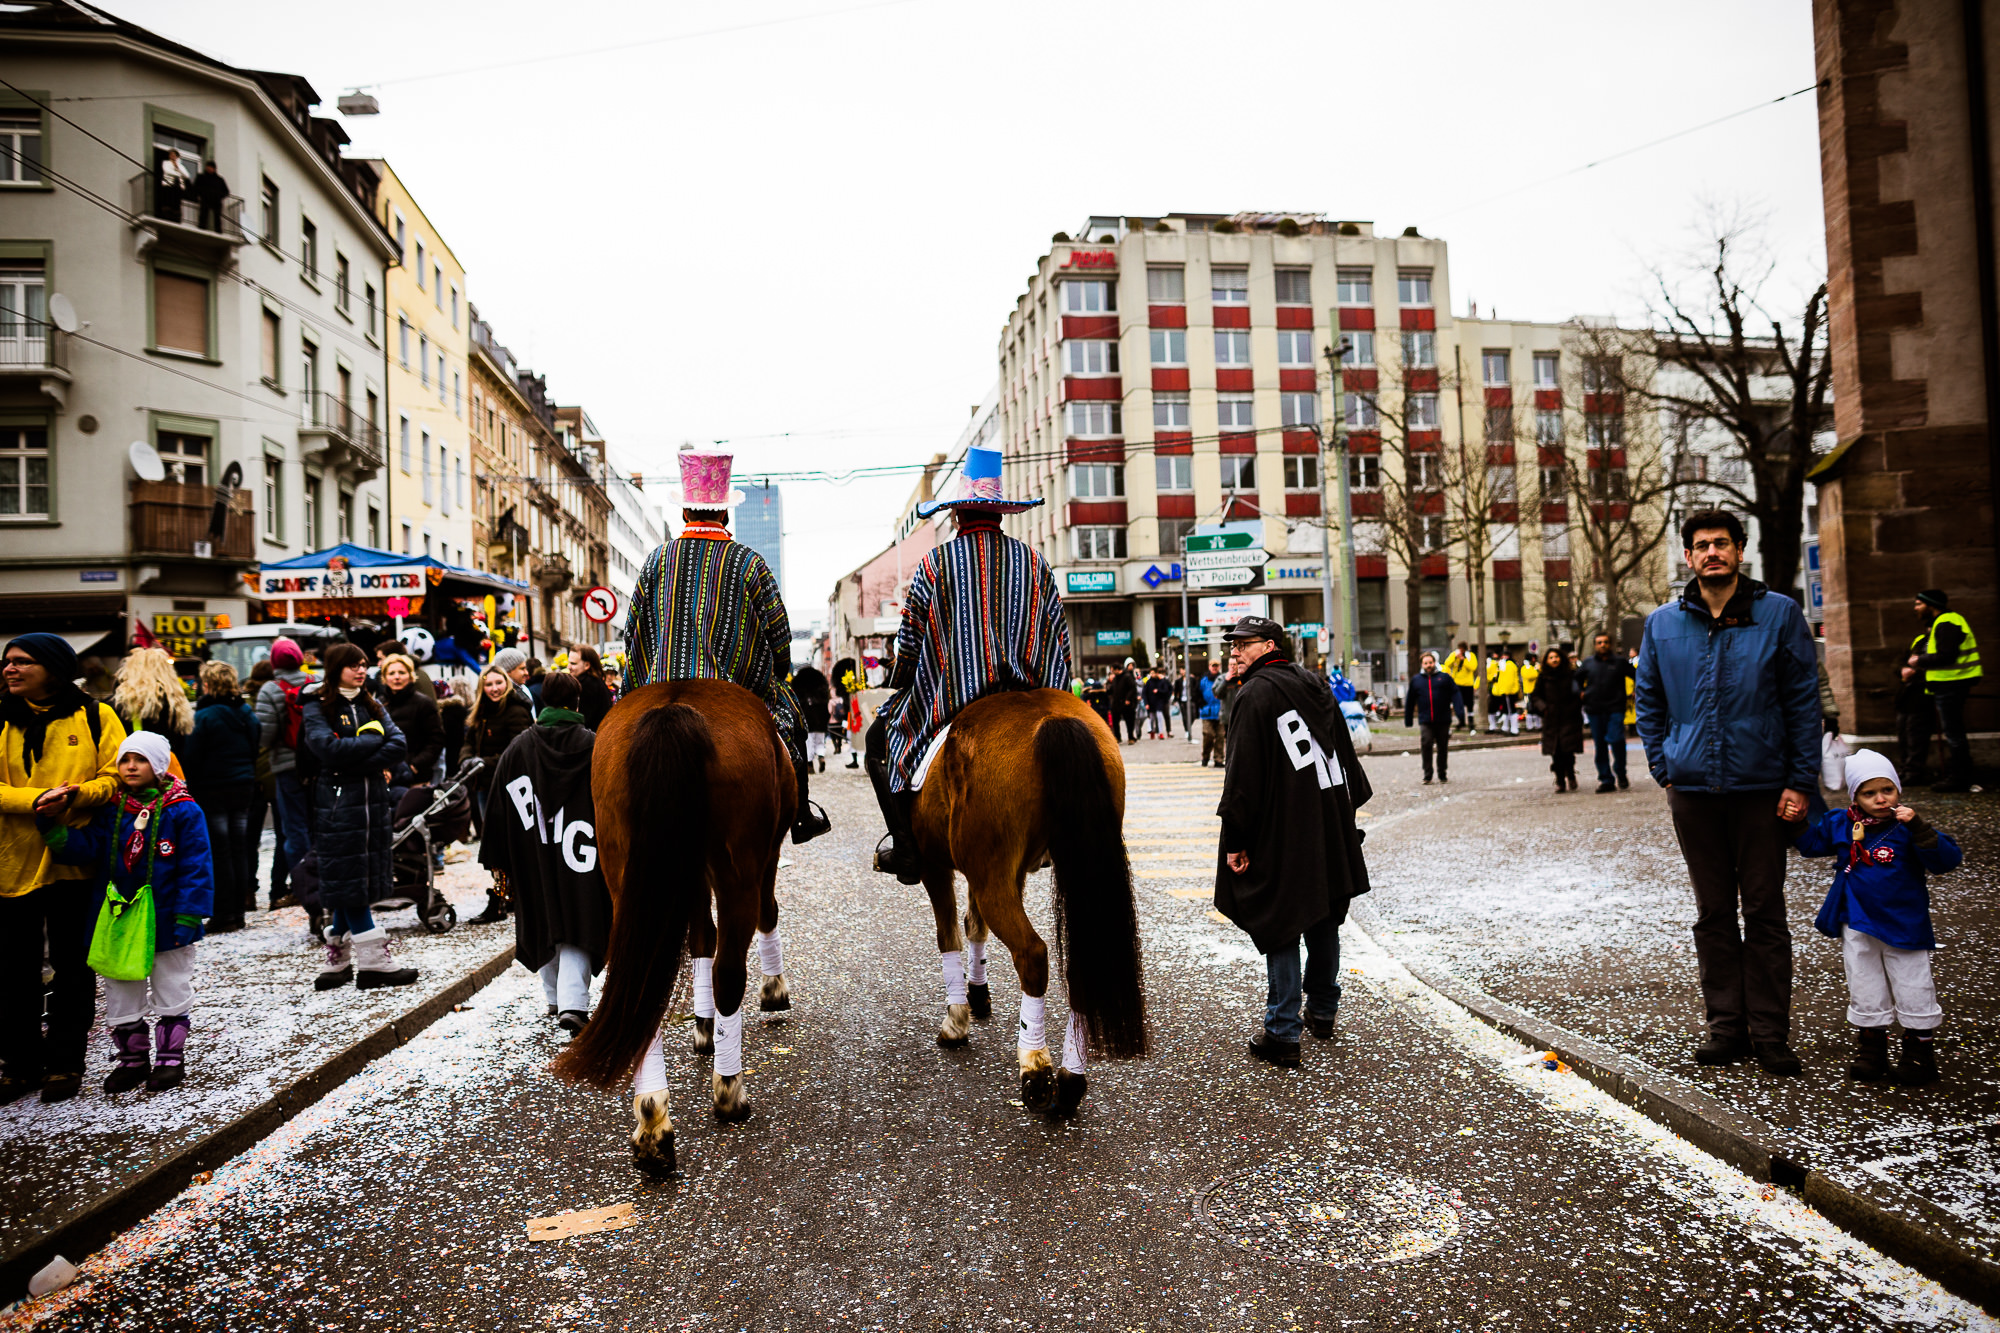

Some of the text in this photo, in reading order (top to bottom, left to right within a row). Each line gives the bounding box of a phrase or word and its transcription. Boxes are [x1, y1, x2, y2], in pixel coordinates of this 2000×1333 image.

[1189, 553, 1262, 567] Wettsteinbrücke
[265, 573, 420, 593] SUMPF DOTTER
[1211, 571, 1248, 582] Polizei
[322, 586, 354, 598] 2016
